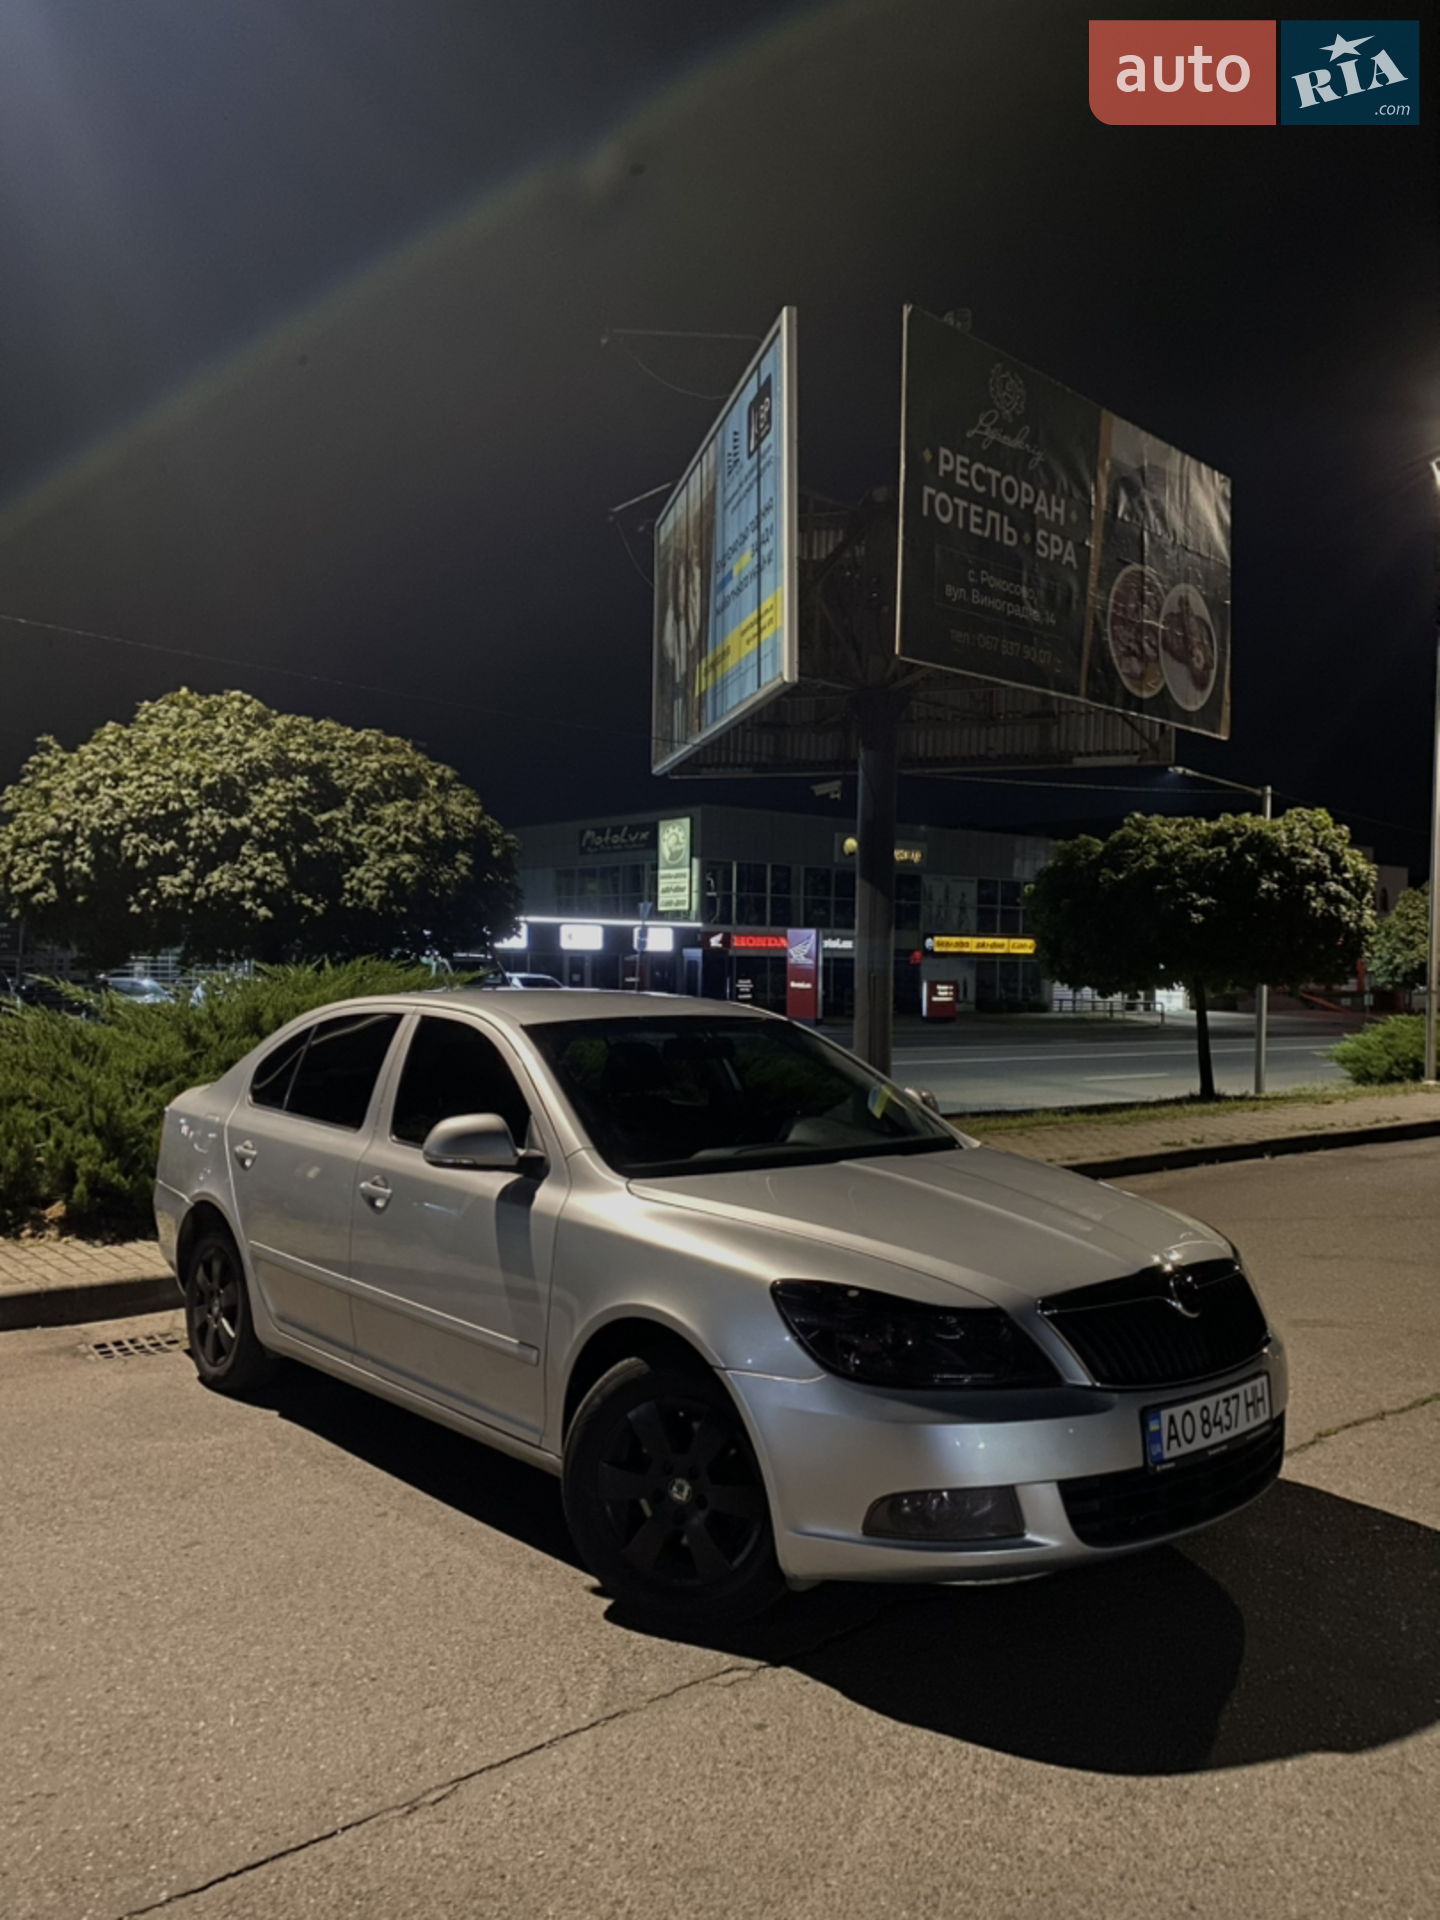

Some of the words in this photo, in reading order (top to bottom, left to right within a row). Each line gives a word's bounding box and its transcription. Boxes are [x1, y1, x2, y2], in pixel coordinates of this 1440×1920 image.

[937, 446, 1066, 526] РЕСТОРАН
[921, 485, 1019, 548] ГОТЕЛЬ
[1035, 529, 1078, 570] SPA
[945, 584, 967, 602] вул.
[732, 935, 787, 947] HONDA
[1166, 1410, 1196, 1452] AO
[1199, 1393, 1240, 1439] 8437
[1243, 1381, 1267, 1423] HH
